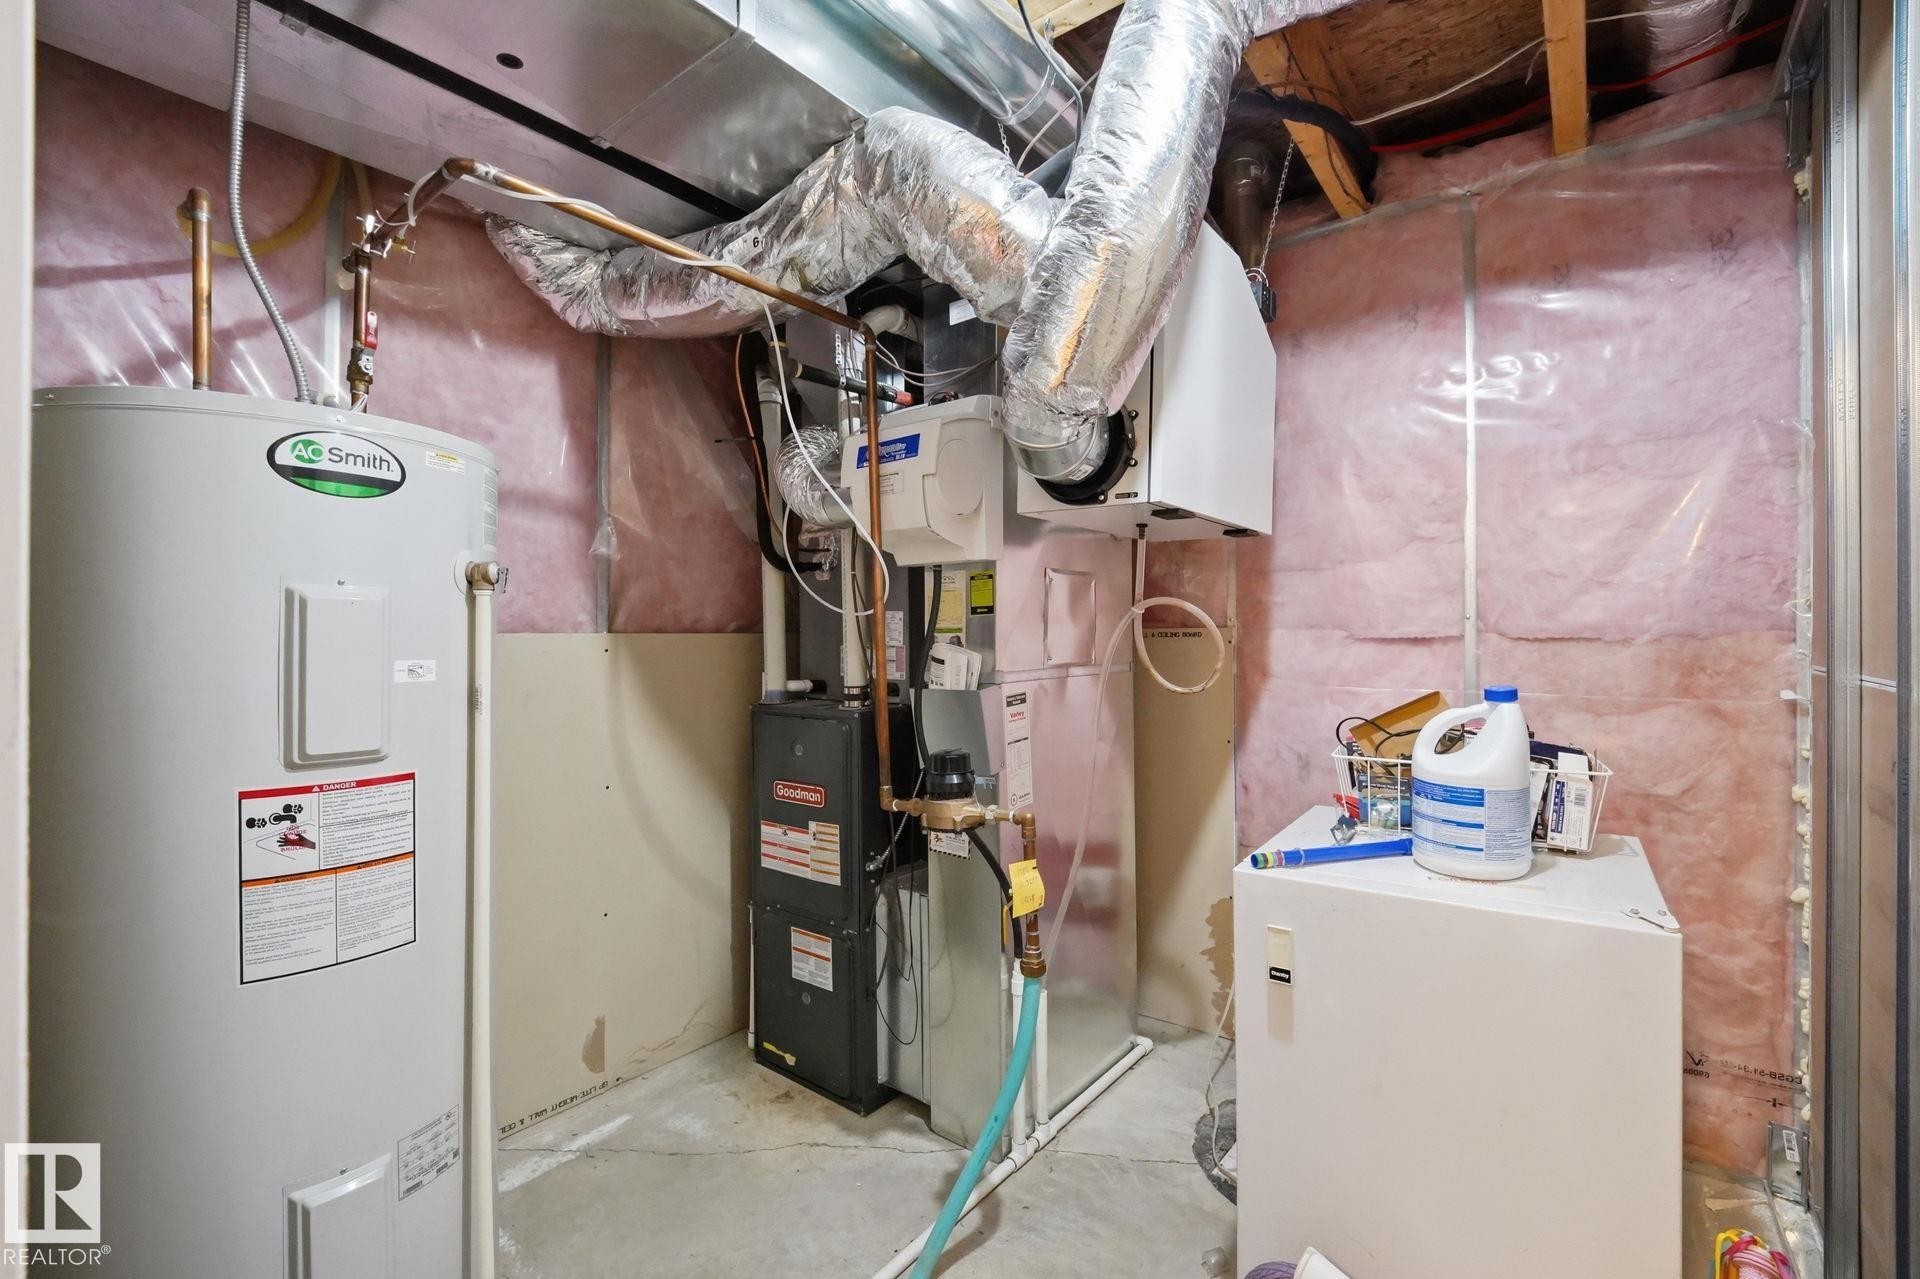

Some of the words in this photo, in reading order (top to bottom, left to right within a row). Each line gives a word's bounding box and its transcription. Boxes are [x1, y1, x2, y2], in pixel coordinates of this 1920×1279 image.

[752, 236, 760, 249] 6
[290, 438, 328, 465] AO
[322, 780, 358, 792] DANGER
[776, 784, 821, 803] Goodman
